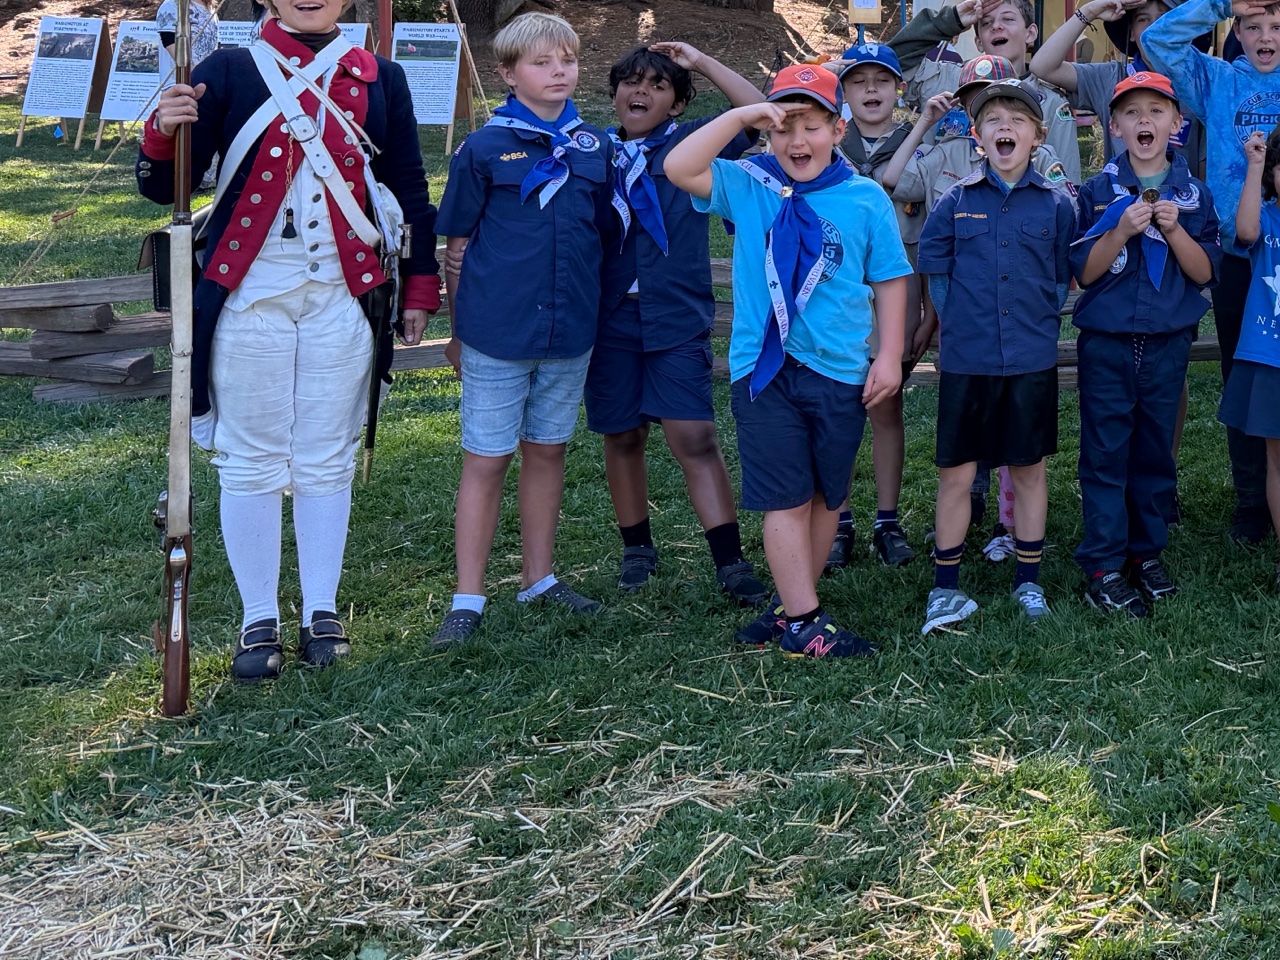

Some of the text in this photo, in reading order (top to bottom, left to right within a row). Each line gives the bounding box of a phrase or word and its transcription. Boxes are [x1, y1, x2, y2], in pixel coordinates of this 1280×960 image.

[1247, 94, 1262, 106] CUB
[1241, 114, 1278, 125] PACK
[510, 151, 528, 160] BSA
